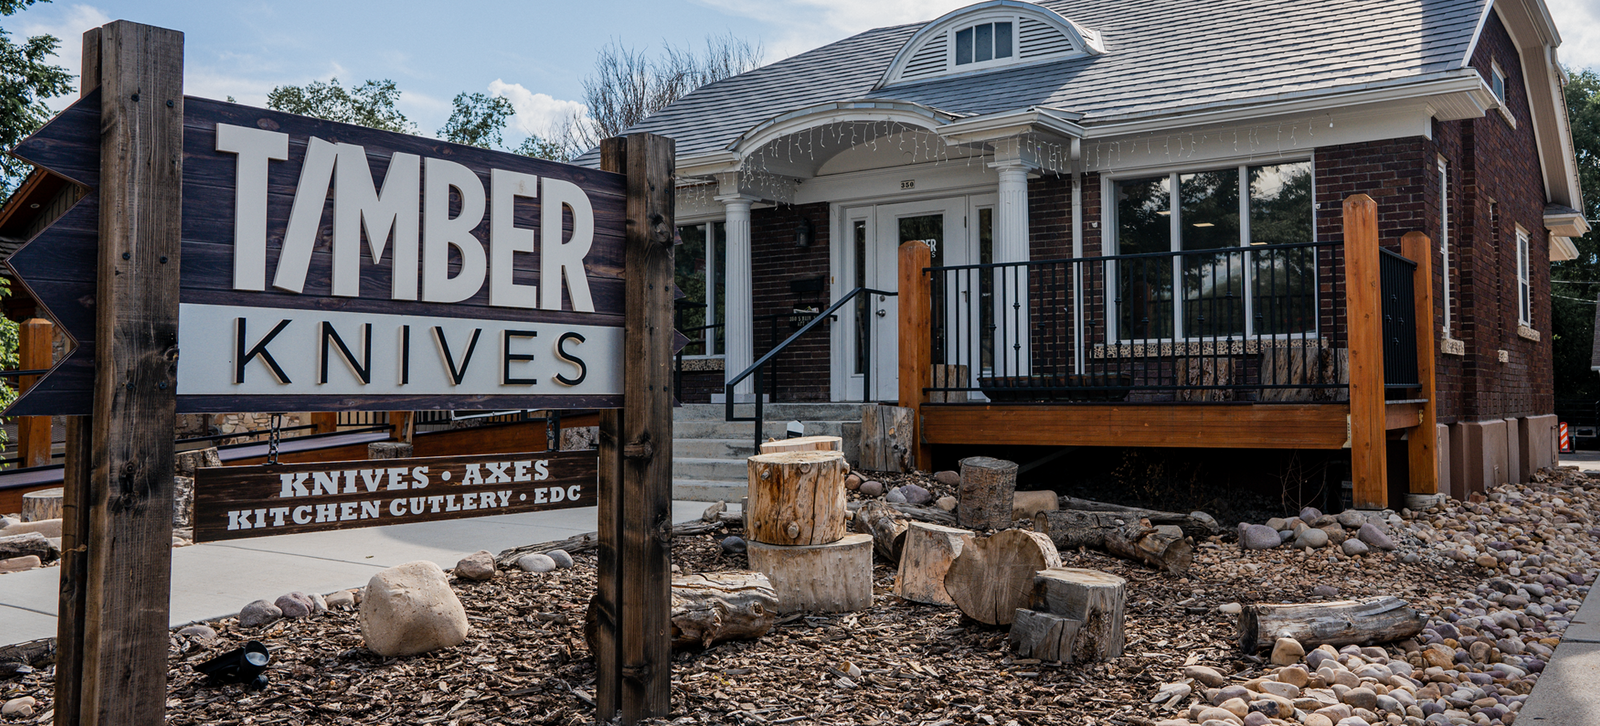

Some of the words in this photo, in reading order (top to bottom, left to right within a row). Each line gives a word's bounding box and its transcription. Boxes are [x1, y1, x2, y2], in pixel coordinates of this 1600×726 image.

[215, 122, 596, 313] TIMBER
[233, 316, 587, 386] KNIVES
[279, 465, 430, 498] KNIVES
[461, 459, 550, 486] AXES
[227, 500, 382, 531] KITCHEN
[388, 490, 513, 517] CUTLERY
[534, 485, 582, 504] EDC
